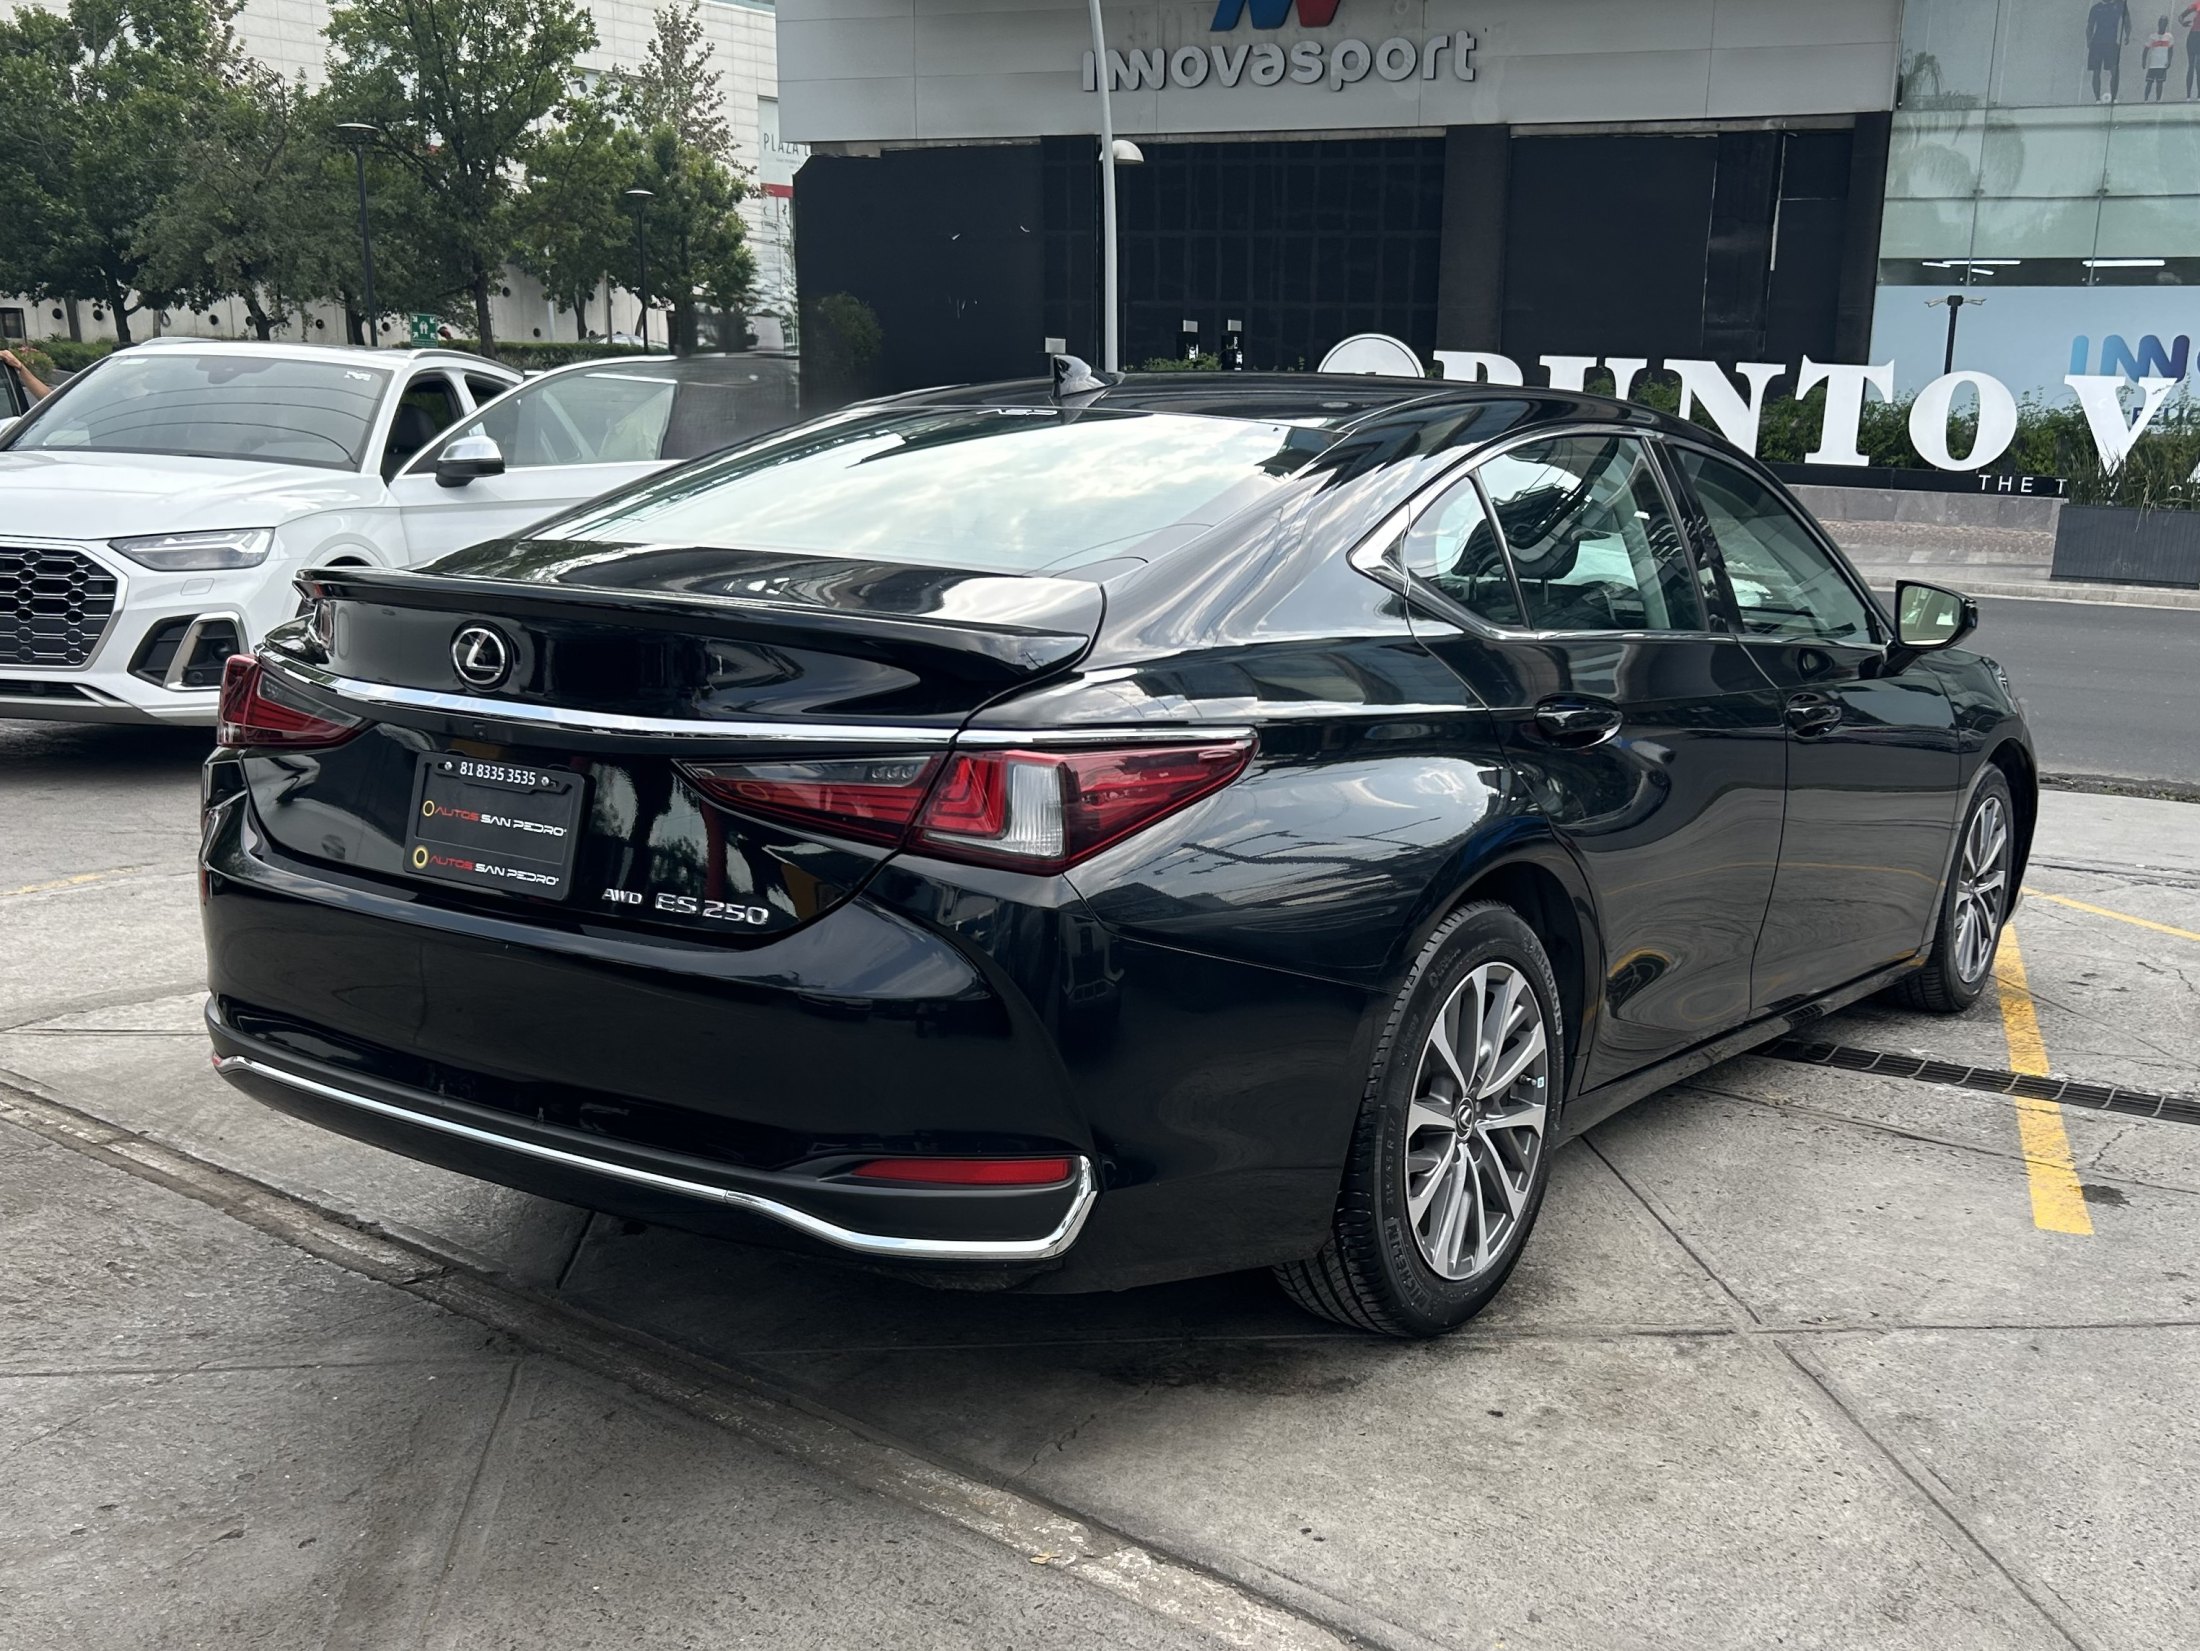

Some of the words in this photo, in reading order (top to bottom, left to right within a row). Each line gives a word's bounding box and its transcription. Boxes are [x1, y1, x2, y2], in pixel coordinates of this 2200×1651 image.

[2069, 334, 2200, 384] INN
[1978, 474, 2034, 494] THE
[459, 761, 474, 776] 81
[476, 764, 505, 782] 8335
[506, 768, 536, 786] 3535
[434, 806, 480, 822] AUTOS
[480, 813, 511, 828] SAN
[429, 855, 475, 871] AUTOS
[474, 863, 506, 876] SAN
[601, 887, 643, 905] AWD
[654, 892, 698, 914] ES
[701, 899, 769, 925] 250
